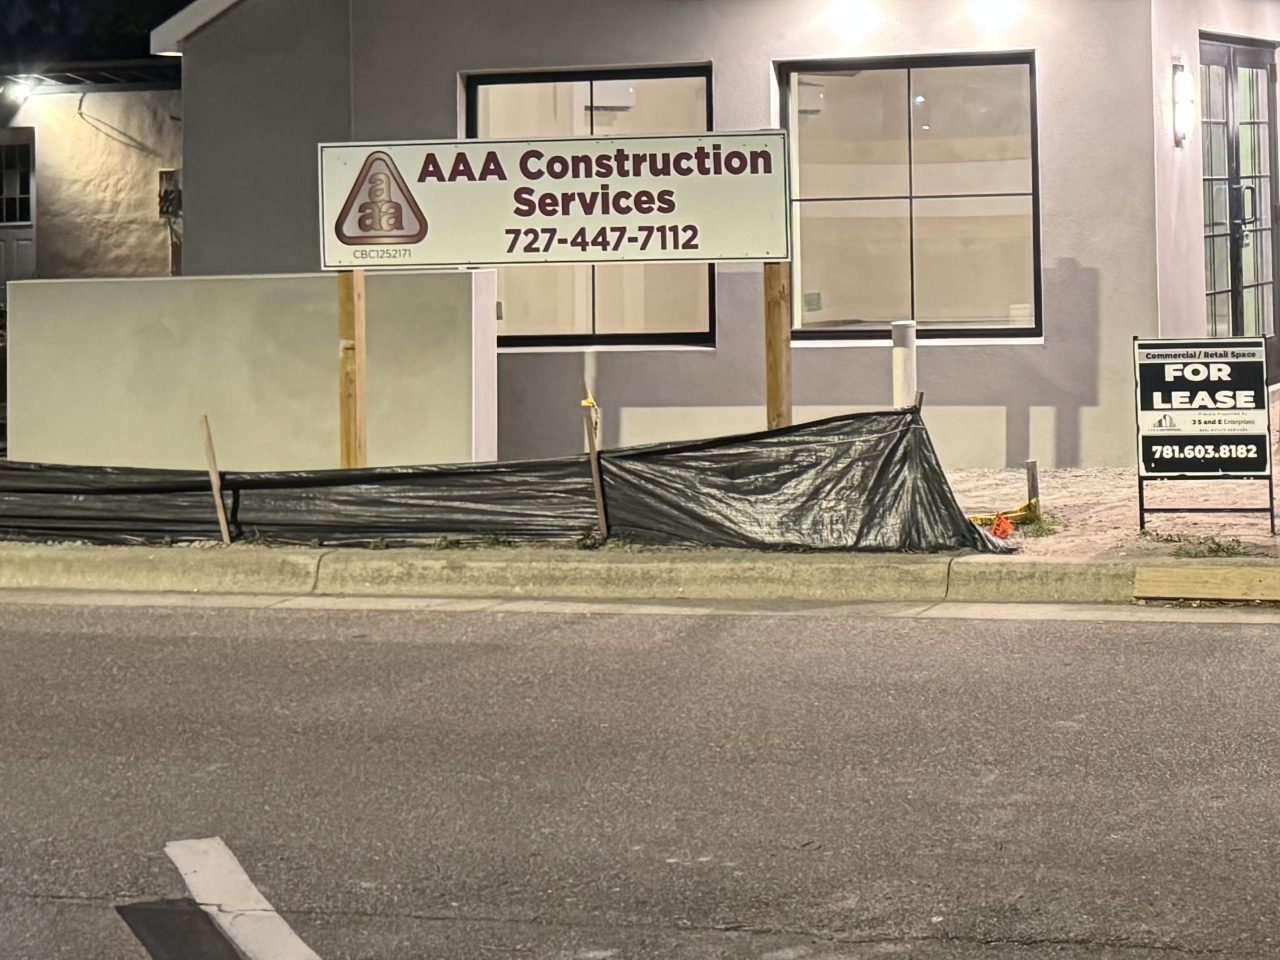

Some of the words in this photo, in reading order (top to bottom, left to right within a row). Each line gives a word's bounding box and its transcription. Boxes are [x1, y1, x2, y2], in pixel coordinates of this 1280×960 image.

[417, 151, 507, 182] AAA
[519, 144, 772, 180] Construction
[513, 184, 676, 217] Services
[505, 224, 699, 253] 727-447-7112
[353, 249, 412, 259] CBC1252171
[1146, 350, 1196, 359] Commercial
[1203, 350, 1229, 358] Retail
[1231, 350, 1256, 359] Space
[1164, 363, 1232, 382] FOR
[1152, 390, 1256, 409] LEASE
[1152, 444, 1258, 459] 781.603.8182
